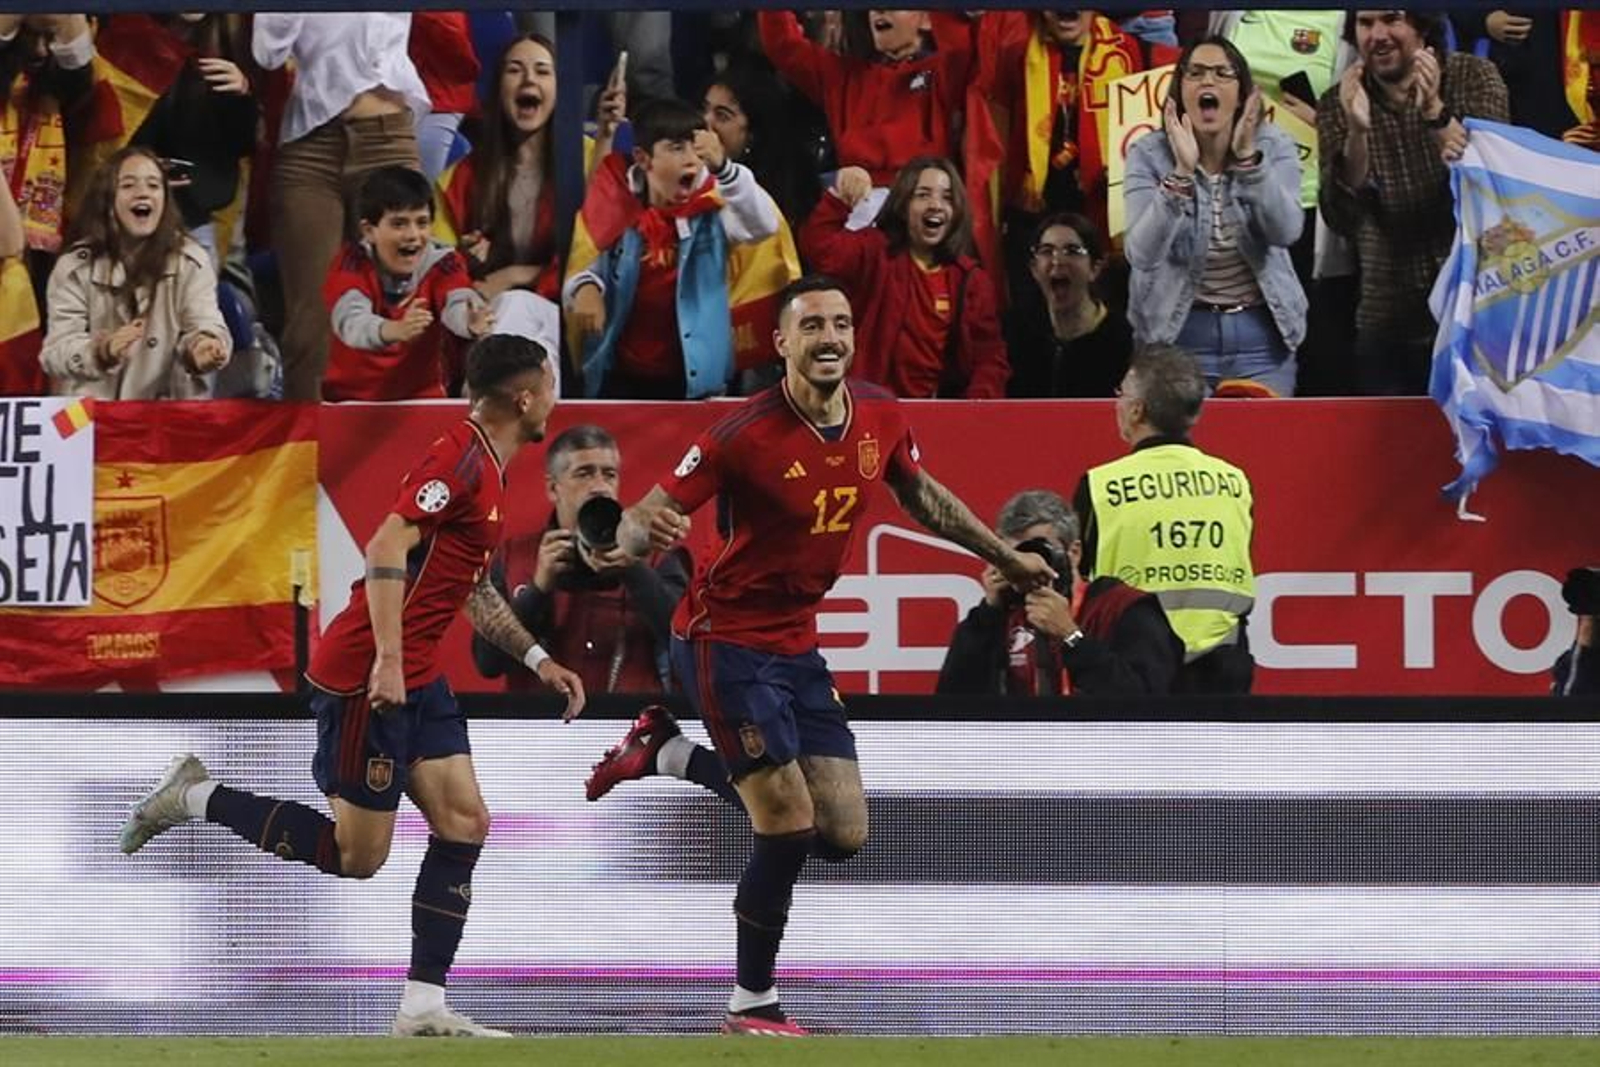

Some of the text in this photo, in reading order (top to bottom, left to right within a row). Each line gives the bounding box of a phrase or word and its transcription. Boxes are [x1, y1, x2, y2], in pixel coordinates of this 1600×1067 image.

[1105, 470, 1243, 507] SEGURIDAD
[810, 486, 858, 534] 12
[1150, 520, 1224, 549] 1670
